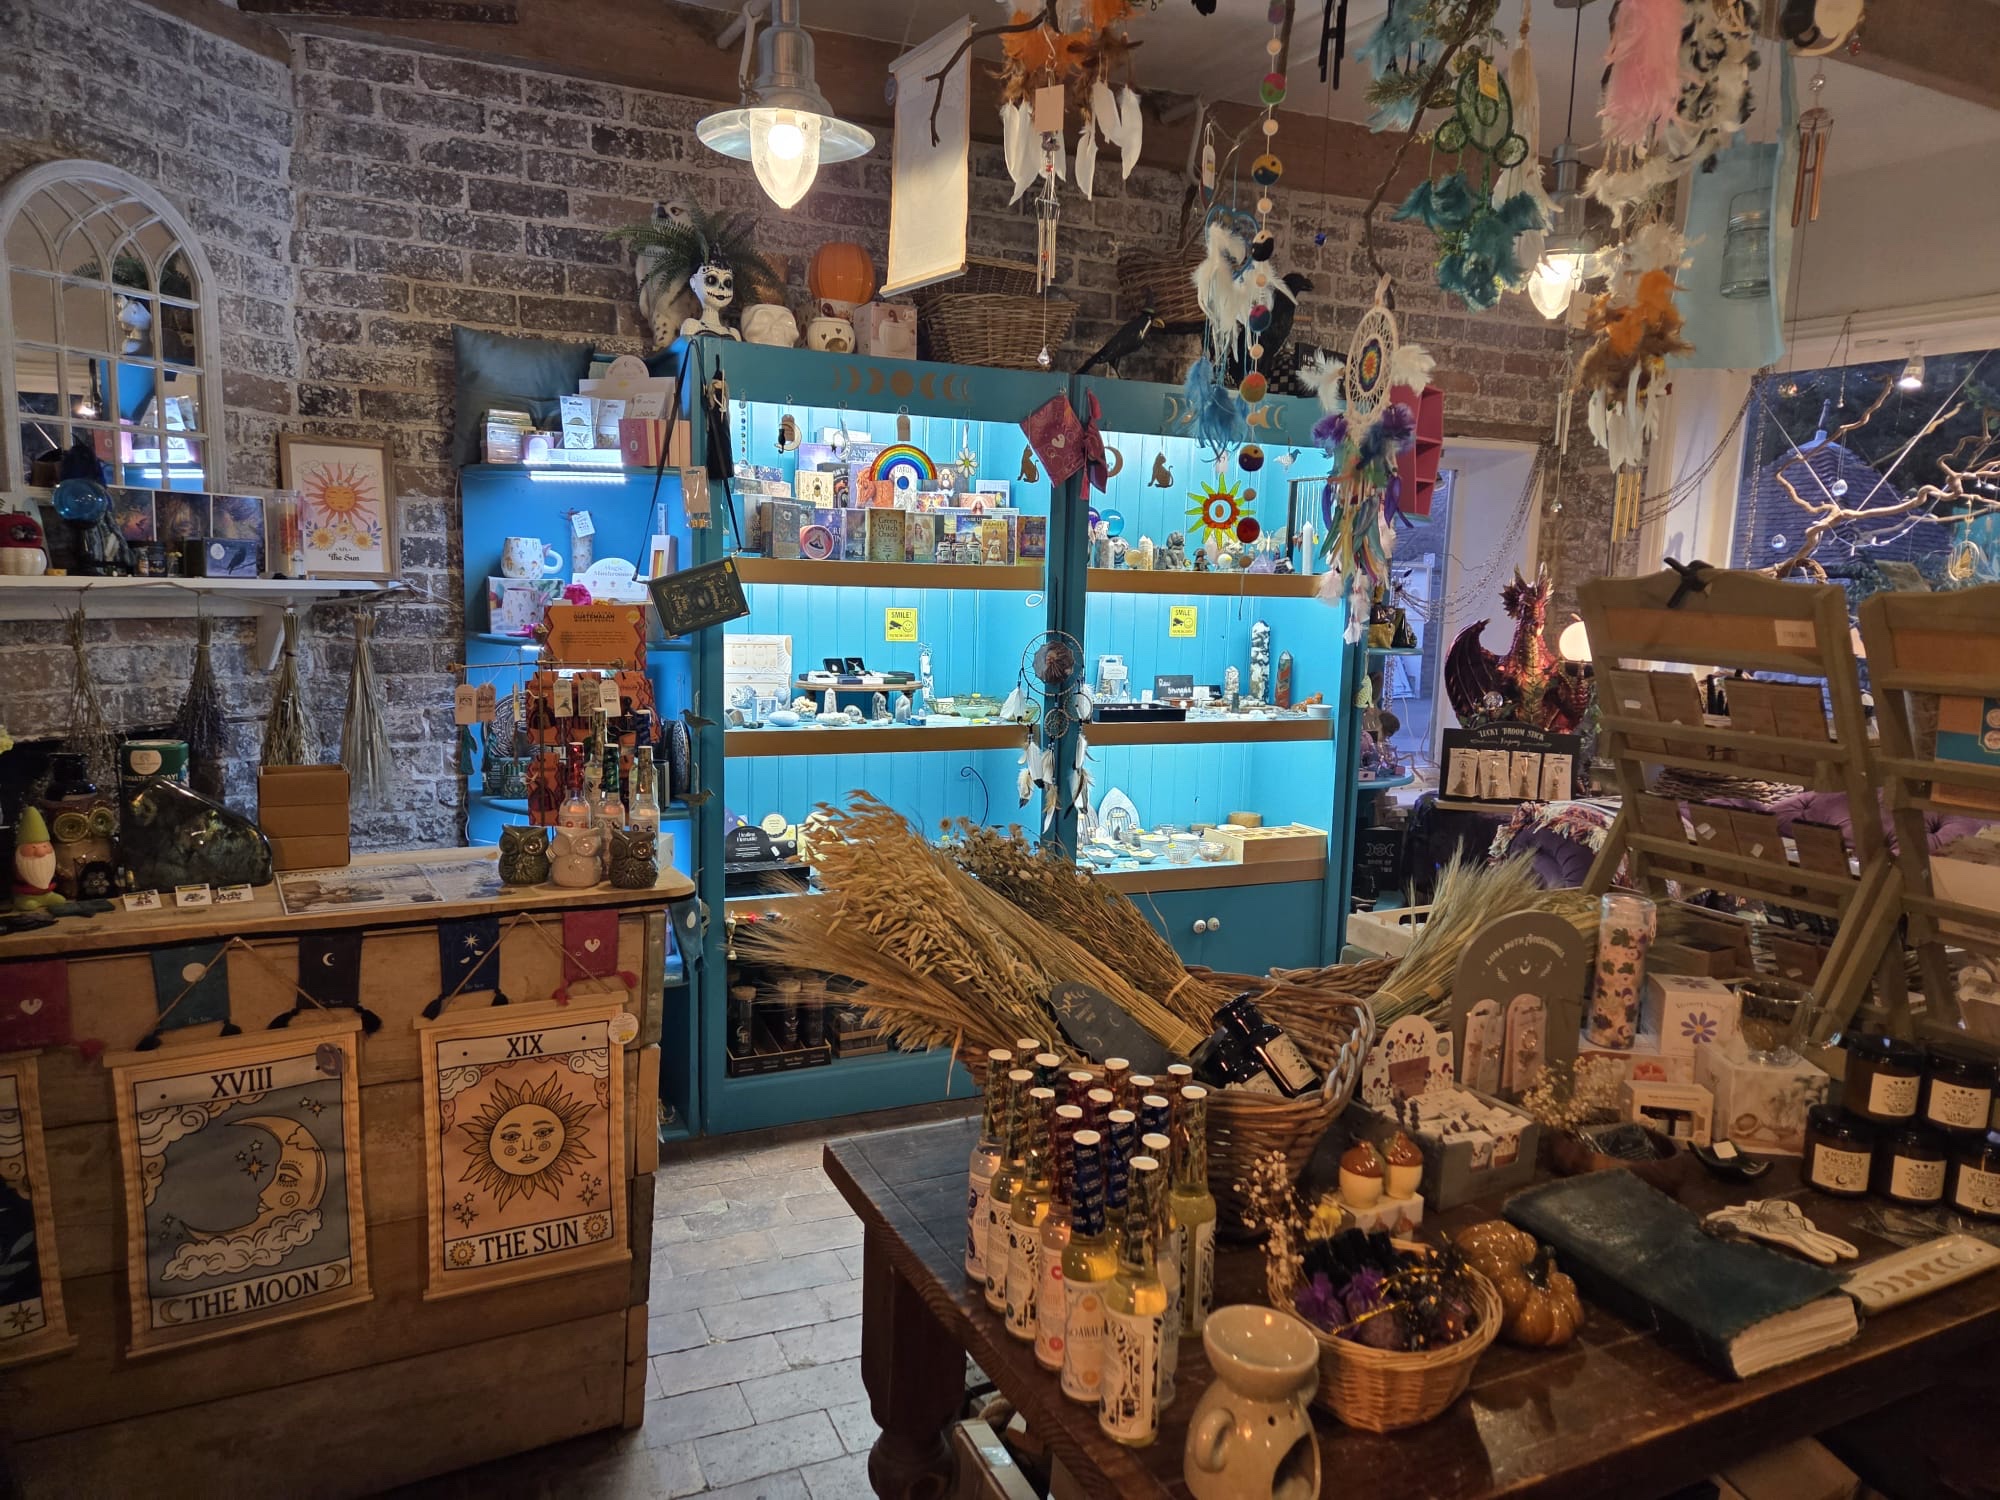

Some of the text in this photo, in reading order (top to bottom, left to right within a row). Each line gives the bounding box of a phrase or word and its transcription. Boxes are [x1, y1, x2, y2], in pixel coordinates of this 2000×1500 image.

[878, 517, 897, 525] Green
[343, 552, 360, 561] Sun
[891, 611, 912, 619] SMILE!
[1478, 727, 1499, 738] LUCKY
[1503, 727, 1525, 737] BROOM
[1485, 947, 1504, 966] LUNA
[506, 1033, 544, 1059] XIX
[211, 1066, 273, 1099] XVIII
[478, 1220, 579, 1263] THE SUN
[184, 1270, 320, 1320] THE MOON
